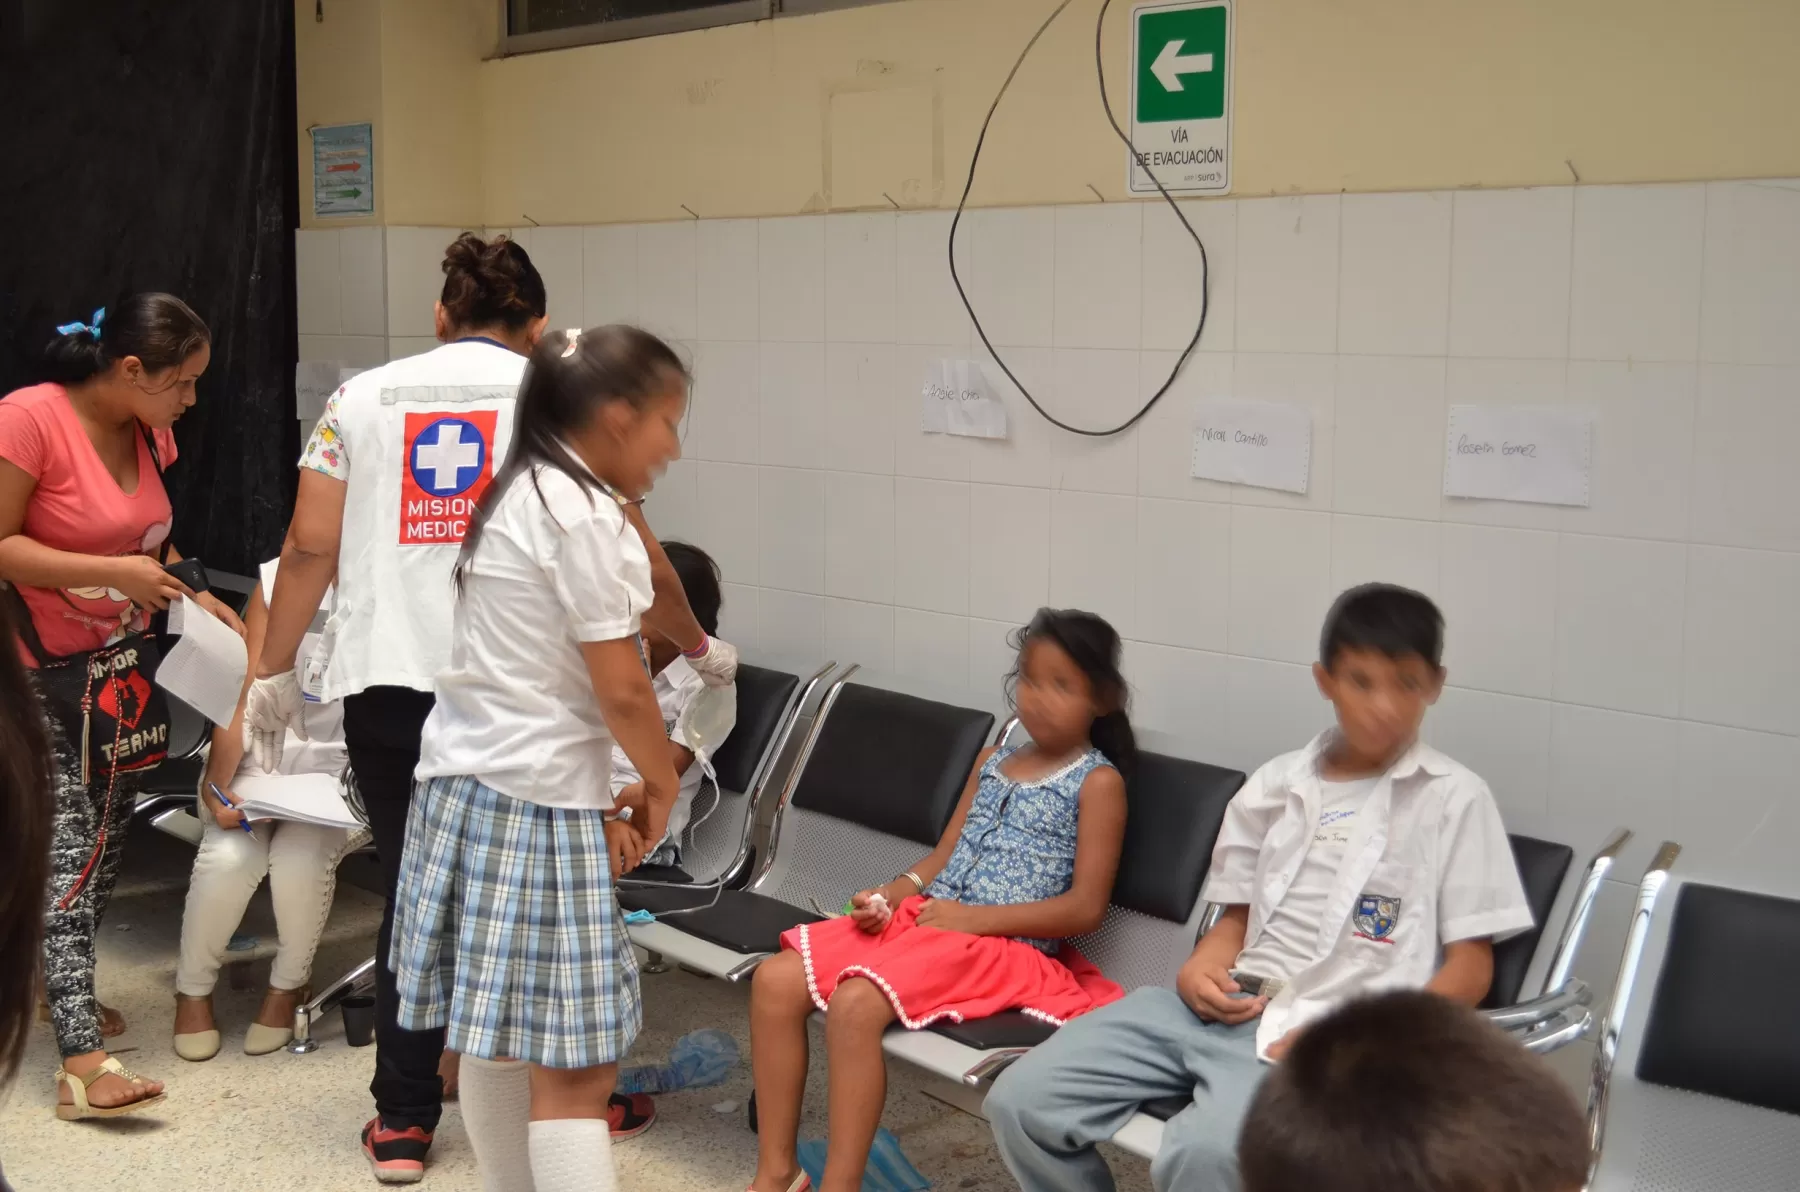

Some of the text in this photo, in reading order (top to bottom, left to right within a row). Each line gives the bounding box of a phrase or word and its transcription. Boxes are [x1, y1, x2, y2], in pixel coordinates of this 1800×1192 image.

[1171, 126, 1189, 144] VÍA
[1136, 146, 1223, 167] DE EVACUACIÓN
[1197, 172, 1215, 182] sura
[407, 520, 467, 539] MEDIC
[88, 648, 138, 679] AMOR
